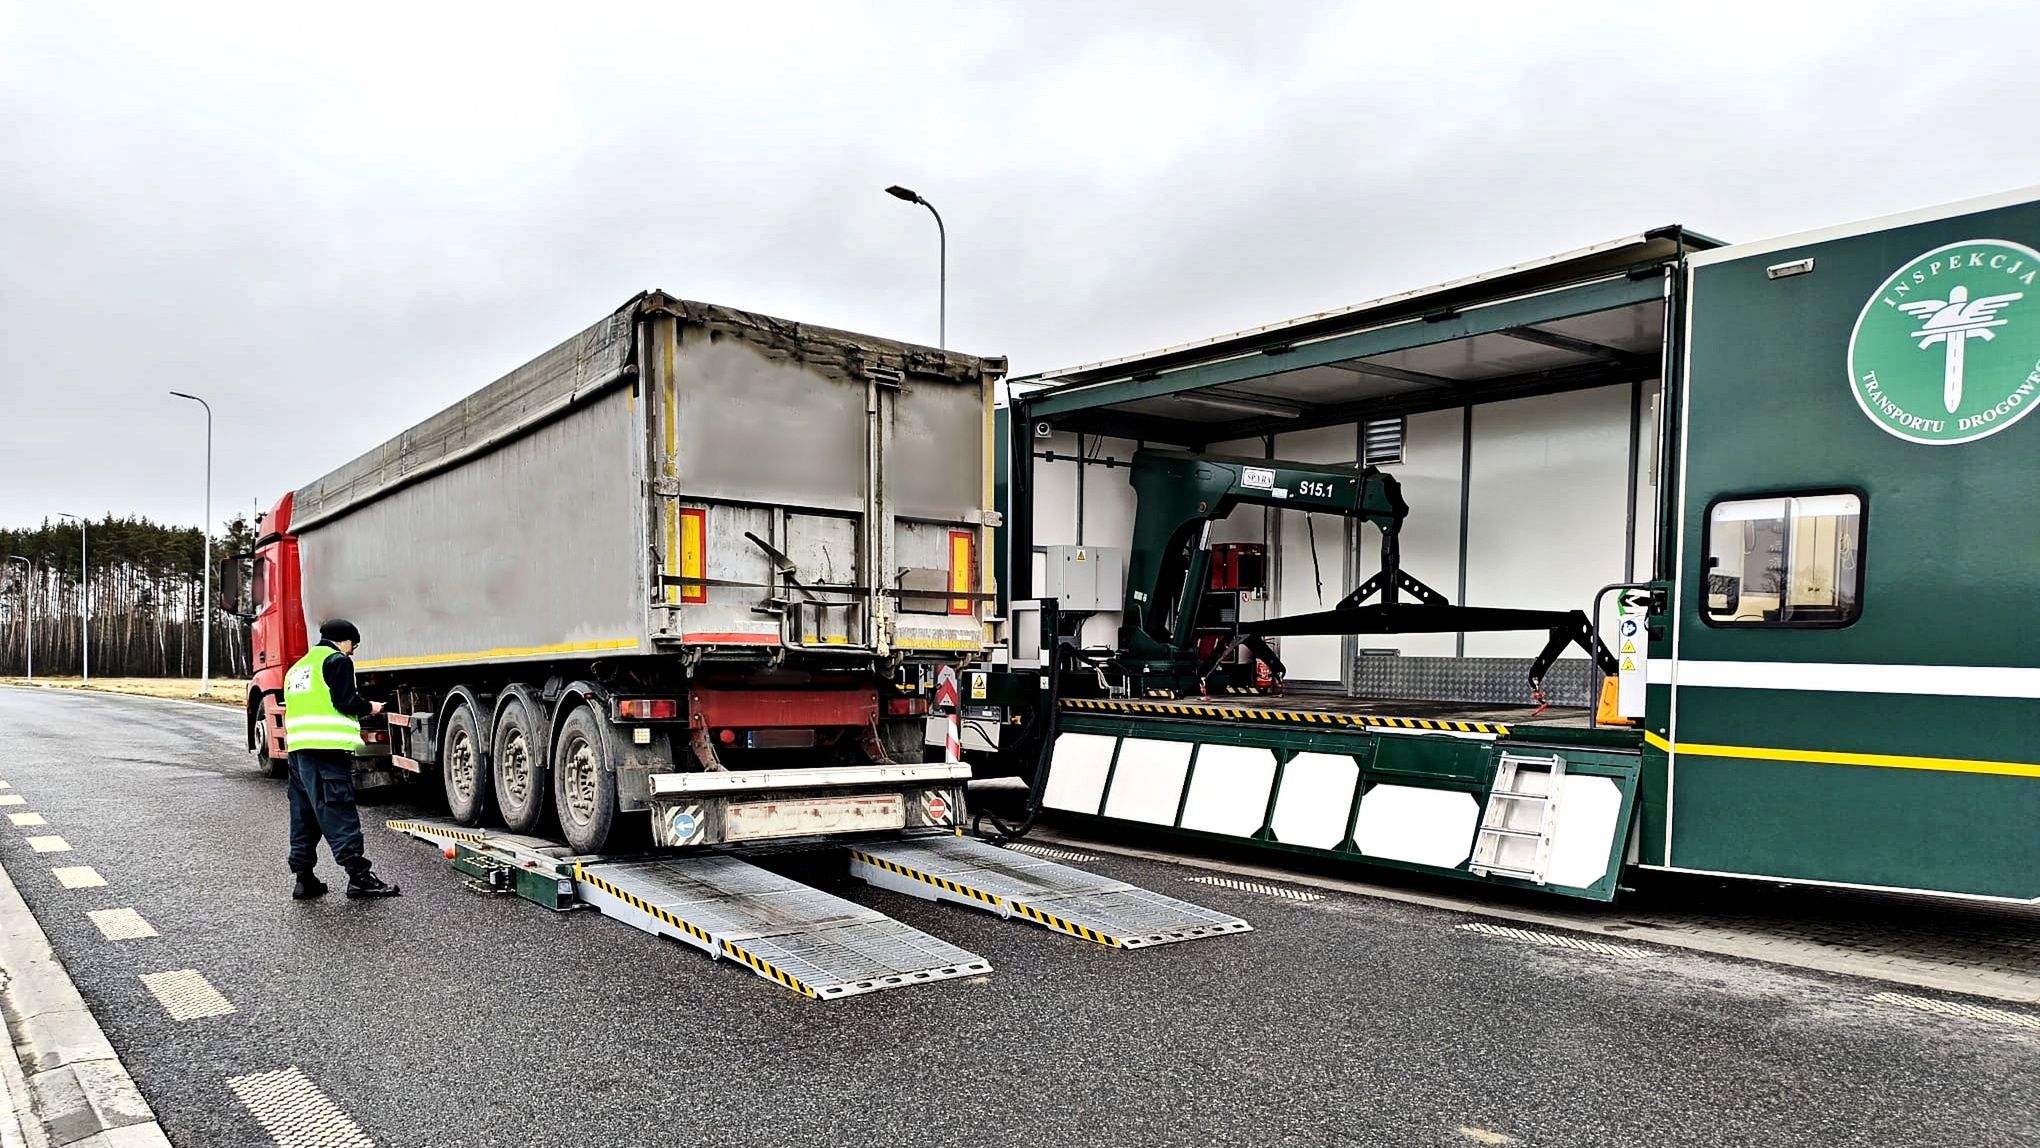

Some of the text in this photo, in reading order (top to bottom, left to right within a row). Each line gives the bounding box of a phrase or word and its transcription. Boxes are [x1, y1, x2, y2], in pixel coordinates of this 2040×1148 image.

[1882, 252, 2038, 307] INSPEKCJA
[1862, 370, 1945, 433] TRANSPORTU
[1299, 481, 1334, 498] S15.1
